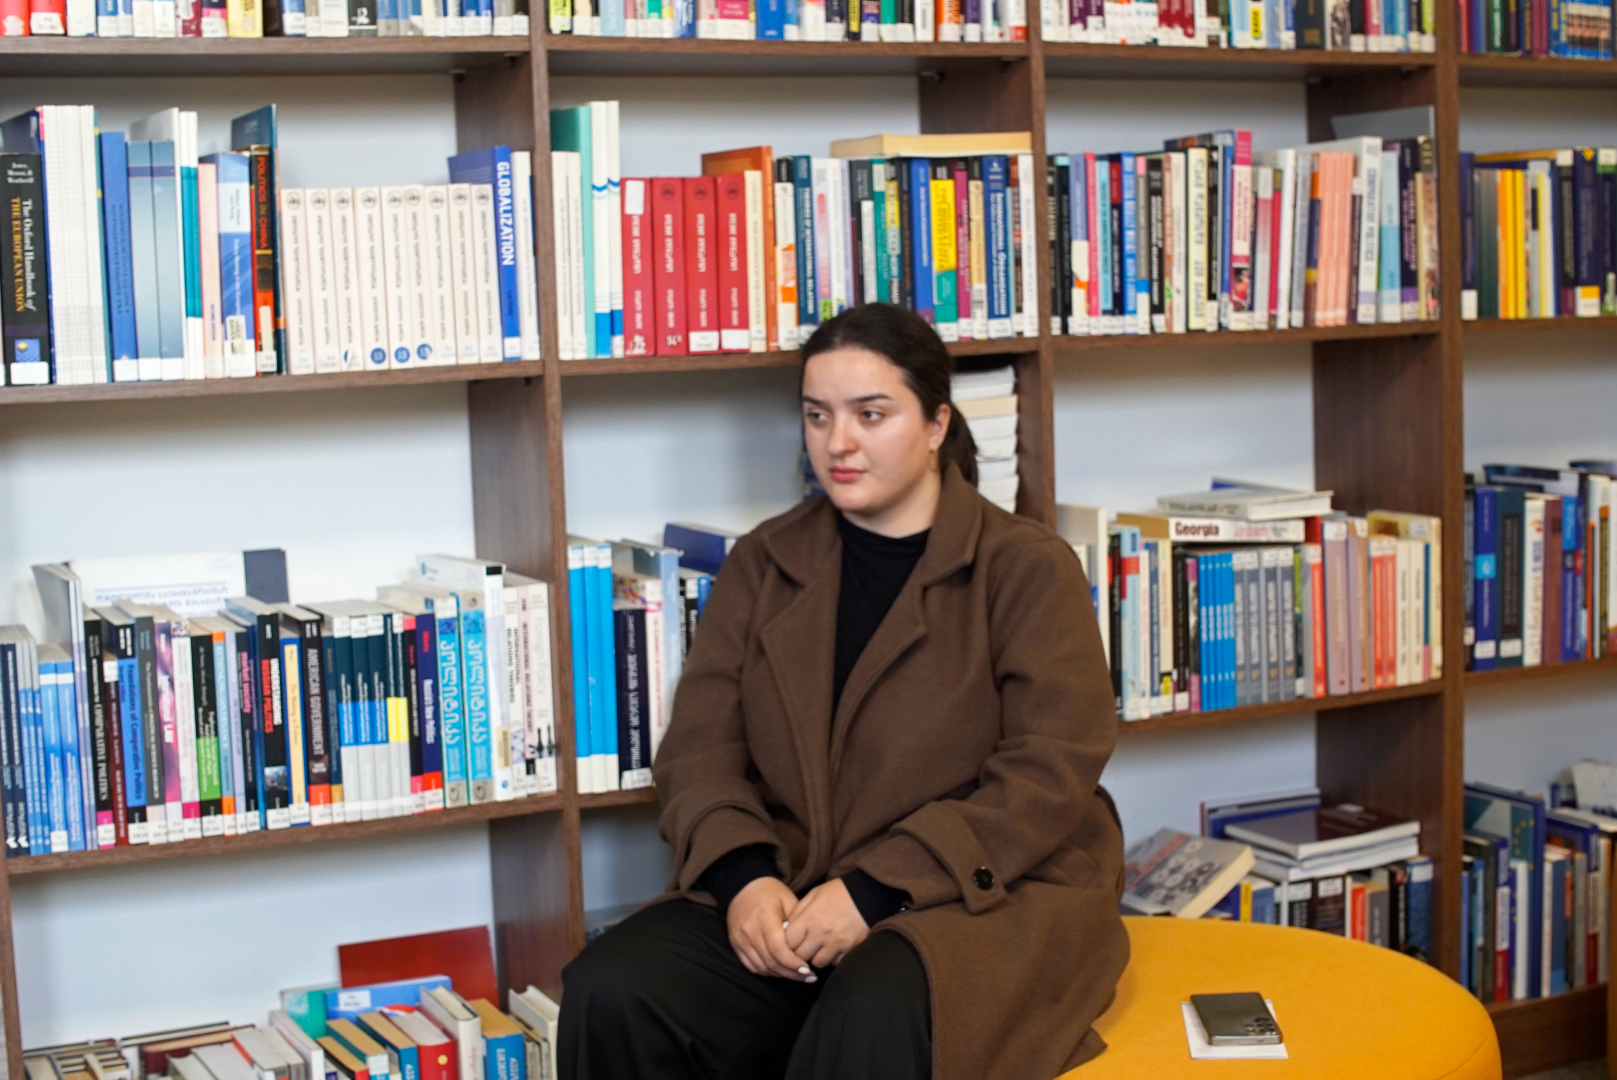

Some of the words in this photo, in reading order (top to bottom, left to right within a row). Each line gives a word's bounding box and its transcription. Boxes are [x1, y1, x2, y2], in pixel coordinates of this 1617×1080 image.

[258, 157, 266, 203] POLITICS
[11, 197, 21, 218] THE
[22, 199, 33, 218] The
[260, 205, 267, 216] IN
[497, 161, 514, 266] GLOBALIZATION
[996, 193, 1005, 250] INTERNATIONAL
[11, 221, 23, 276] EUROPEAN
[23, 219, 34, 250] Oxford
[260, 217, 268, 249] CHINA
[805, 229, 813, 278] INTERNATIONAL
[24, 252, 36, 297] Handbook
[15, 278, 25, 311] UNION
[24, 299, 37, 311] of
[1174, 521, 1219, 538] Georgia
[513, 626, 521, 685] INTERNATIONAL
[533, 616, 546, 659] Foreign
[241, 652, 250, 681] market
[262, 660, 273, 696] RUSSIAN
[306, 648, 319, 695] AMERICAN
[535, 660, 548, 696] Policy
[126, 664, 136, 712] Foundations
[160, 674, 173, 722] International
[242, 682, 251, 713] society
[271, 657, 282, 726] UNDERSTANDING
[422, 679, 435, 705] Russia's
[440, 639, 460, 744] პოლიტიკა
[468, 639, 486, 744] პოლიტიკა
[523, 673, 531, 707] RELATIONS
[264, 697, 274, 733] POLITICS
[309, 696, 324, 756] GOVERNMENT
[424, 705, 435, 719] New
[94, 703, 107, 761] COMPARATIVE
[130, 722, 140, 771] Comparative
[163, 724, 174, 743] LAW
[425, 719, 435, 744] Politics
[97, 762, 108, 801] POLITICS
[133, 772, 143, 800] Politics
